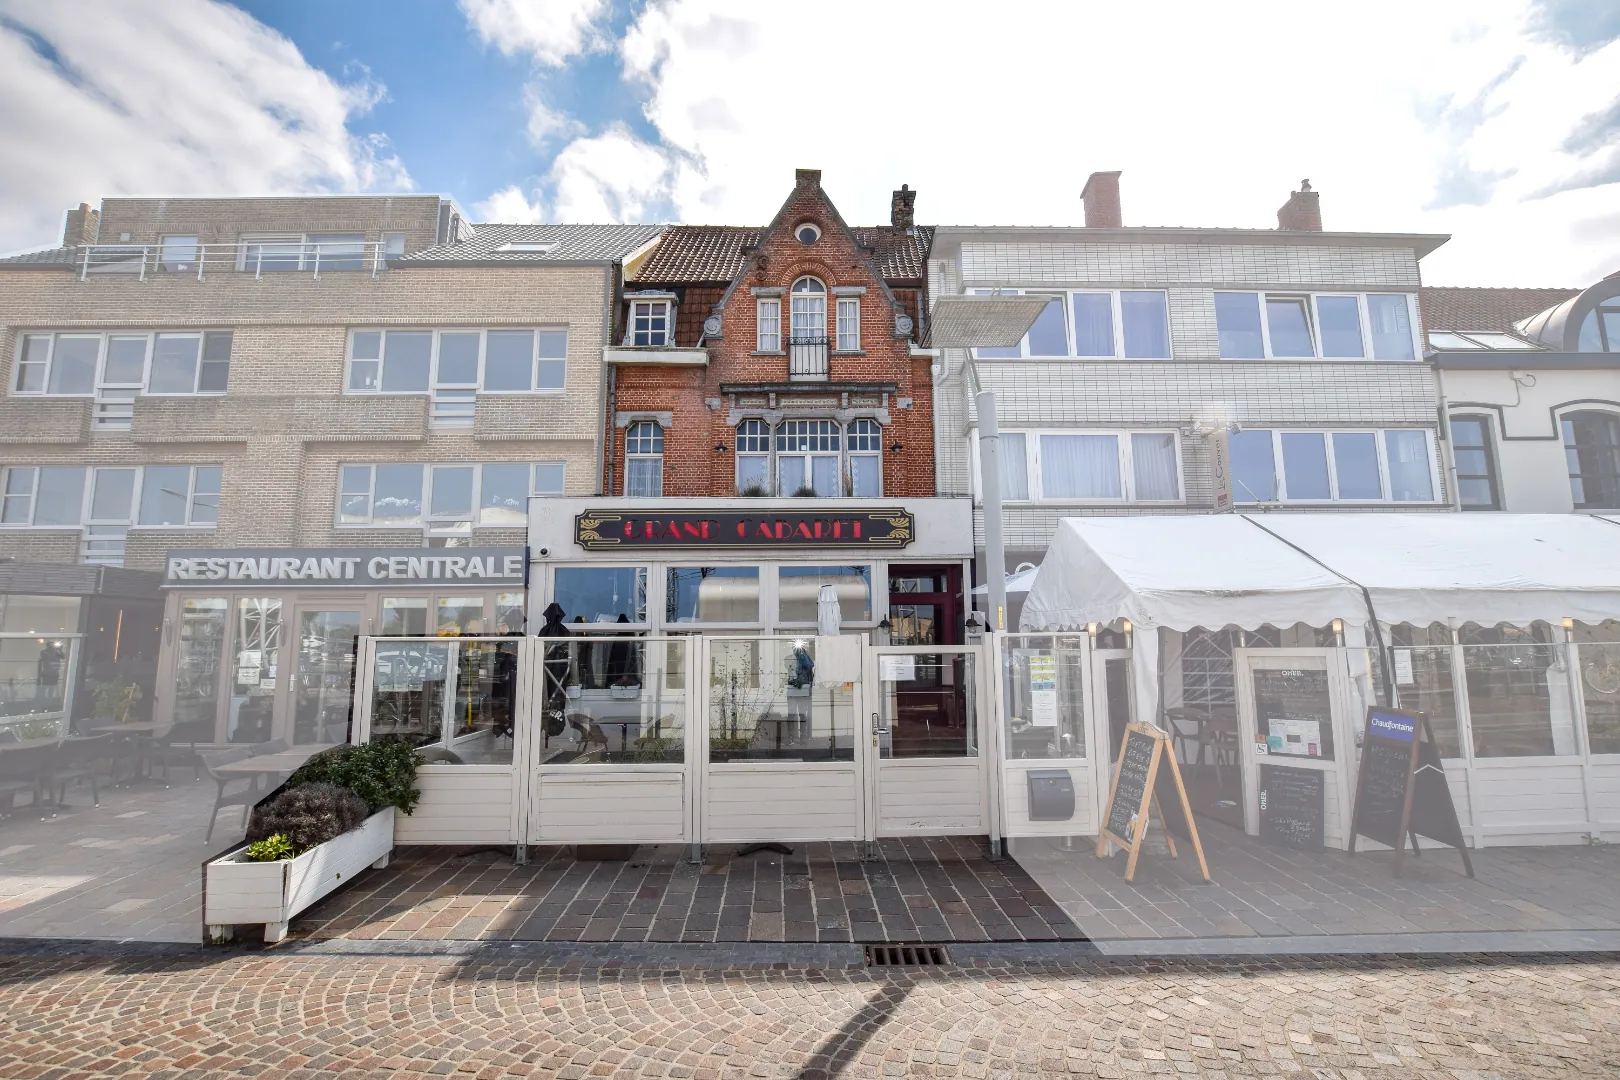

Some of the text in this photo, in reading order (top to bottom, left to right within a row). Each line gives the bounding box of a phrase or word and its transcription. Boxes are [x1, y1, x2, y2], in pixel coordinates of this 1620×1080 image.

[623, 519, 721, 539] GRAND
[167, 555, 523, 580] RESTAURANT CENTRALE
[1371, 718, 1414, 733] Chaudfontaine
